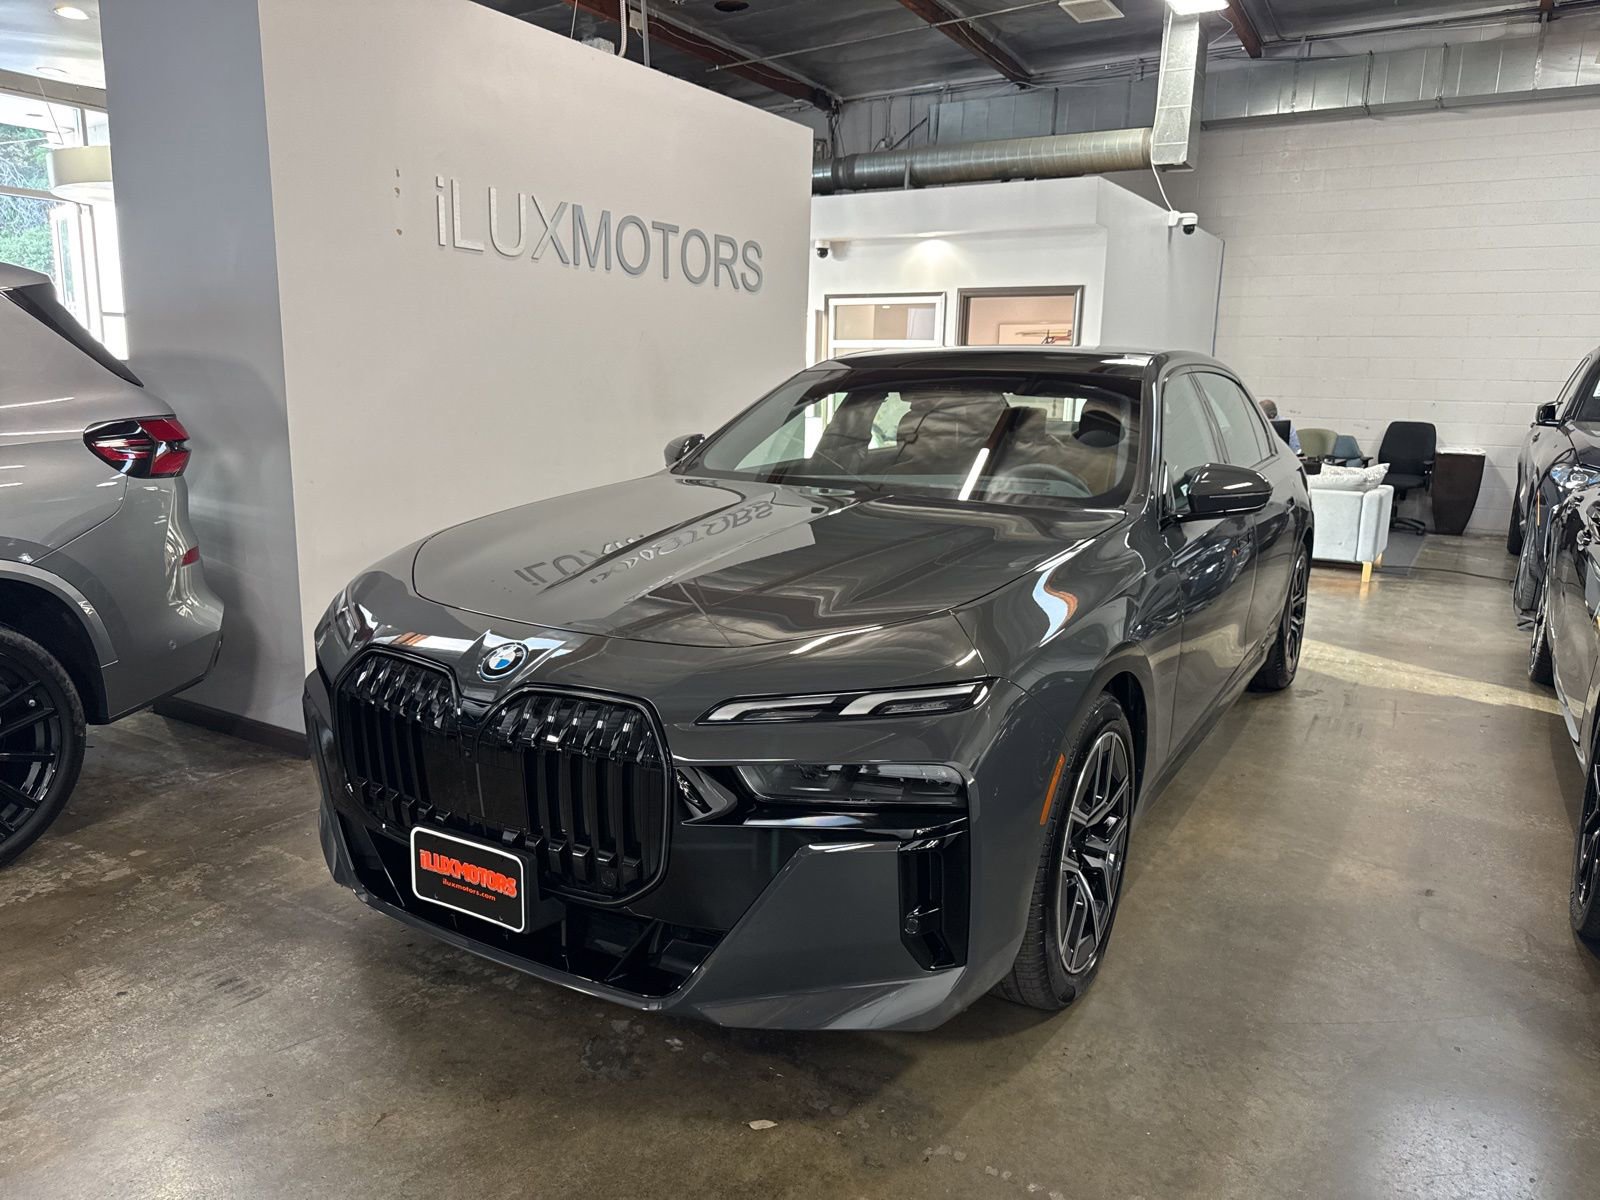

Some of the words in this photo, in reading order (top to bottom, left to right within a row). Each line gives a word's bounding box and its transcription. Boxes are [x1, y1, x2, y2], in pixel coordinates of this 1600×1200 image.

[435, 175, 764, 293] iLUXMOTORS
[419, 848, 518, 899] iLUXMOTORS
[442, 878, 497, 902] iluxmotors.com
